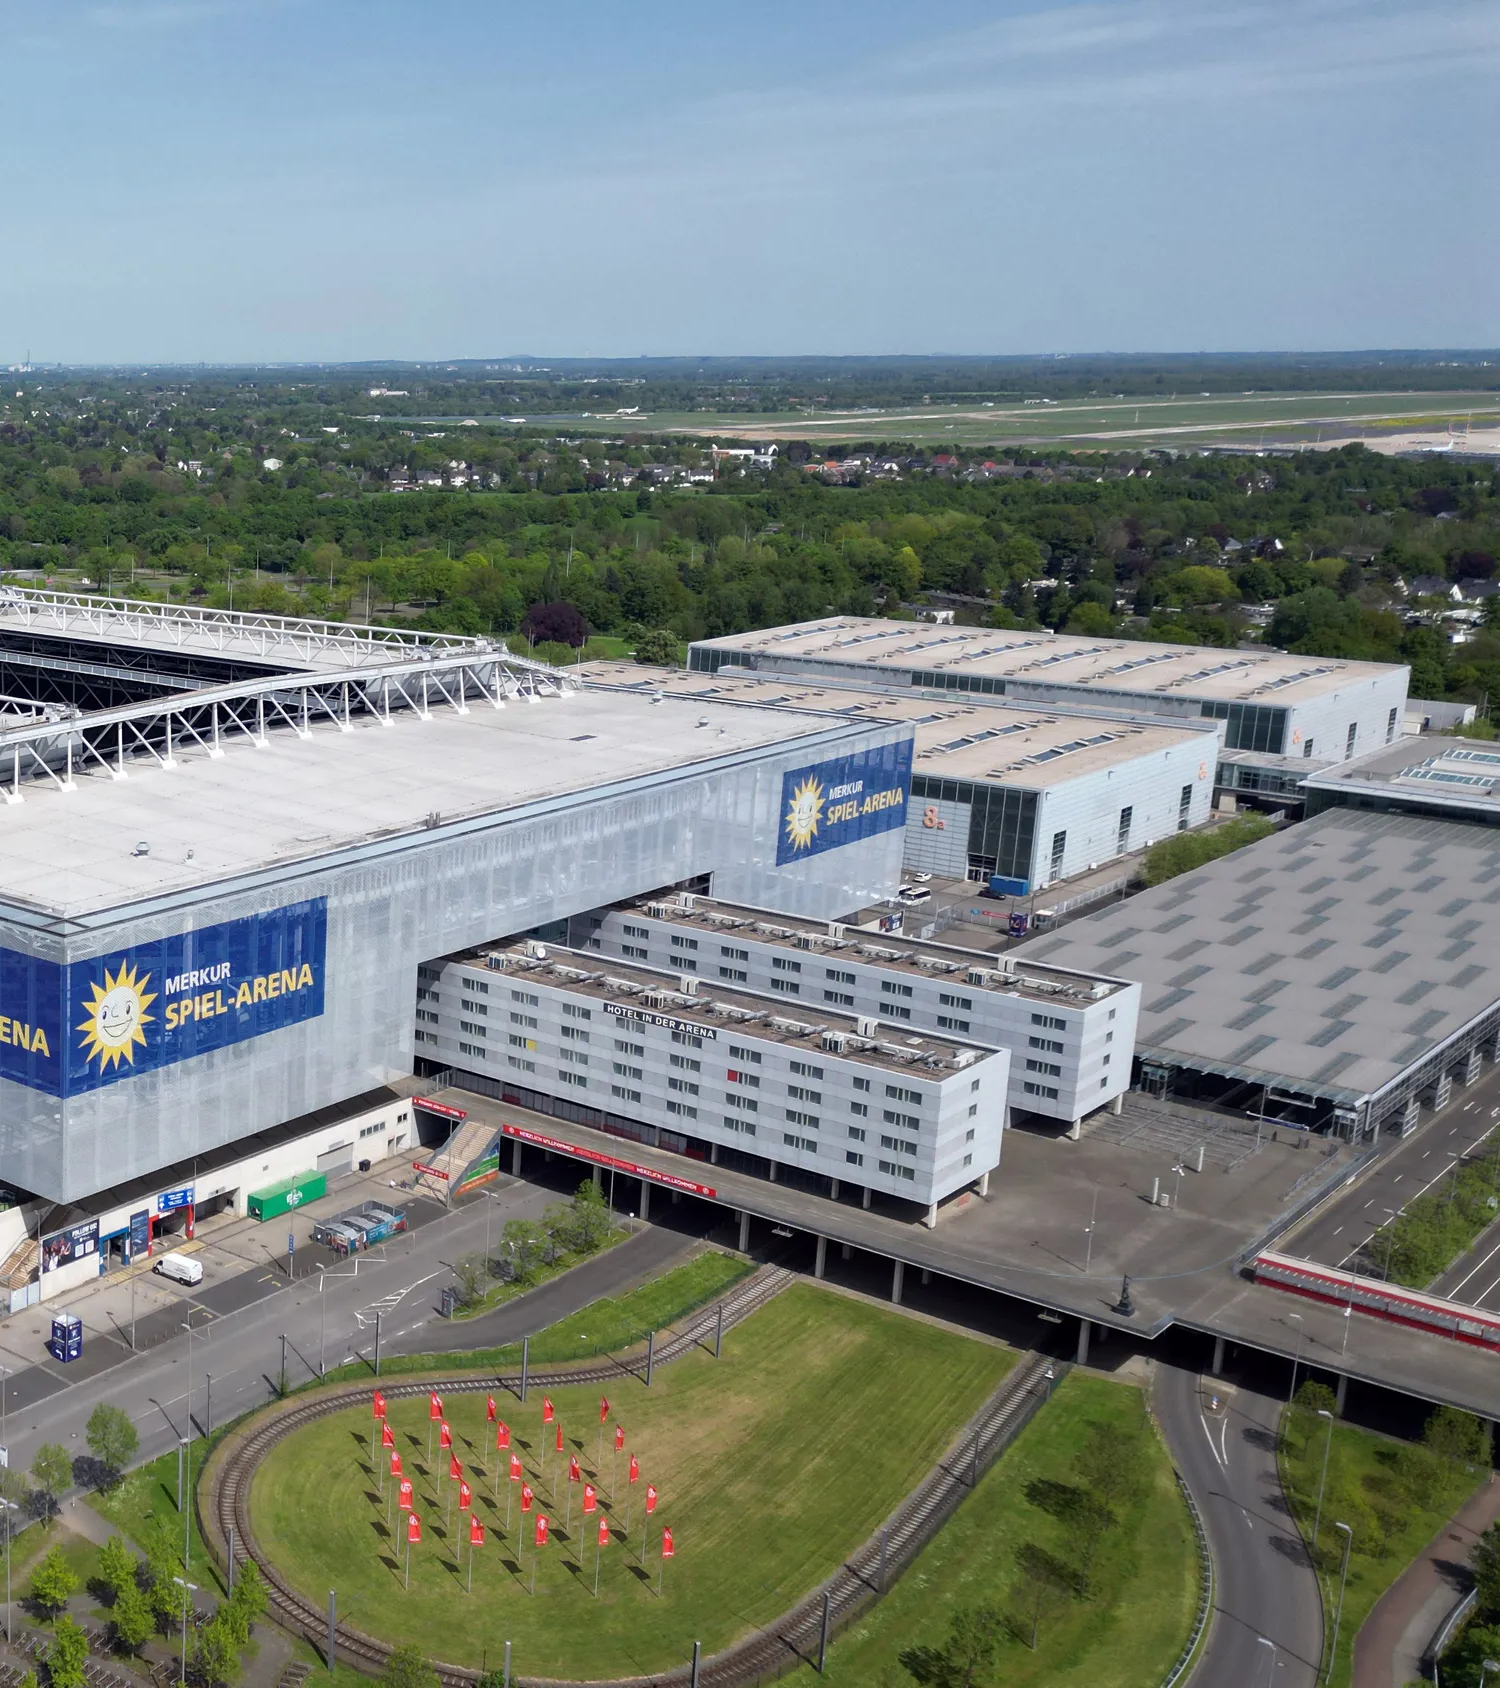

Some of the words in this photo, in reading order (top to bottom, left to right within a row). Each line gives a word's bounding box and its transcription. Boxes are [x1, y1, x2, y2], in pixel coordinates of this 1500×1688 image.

[826, 787, 903, 826] SPIEL-ARENA
[828, 780, 864, 801] MERKUR
[165, 961, 231, 996] MERKUR
[165, 963, 314, 1031] SPIEL-ARENA
[607, 1005, 639, 1020] HOTEL
[642, 1013, 652, 1023] IN
[655, 1017, 676, 1029] DER
[678, 1023, 714, 1039] ARENA
